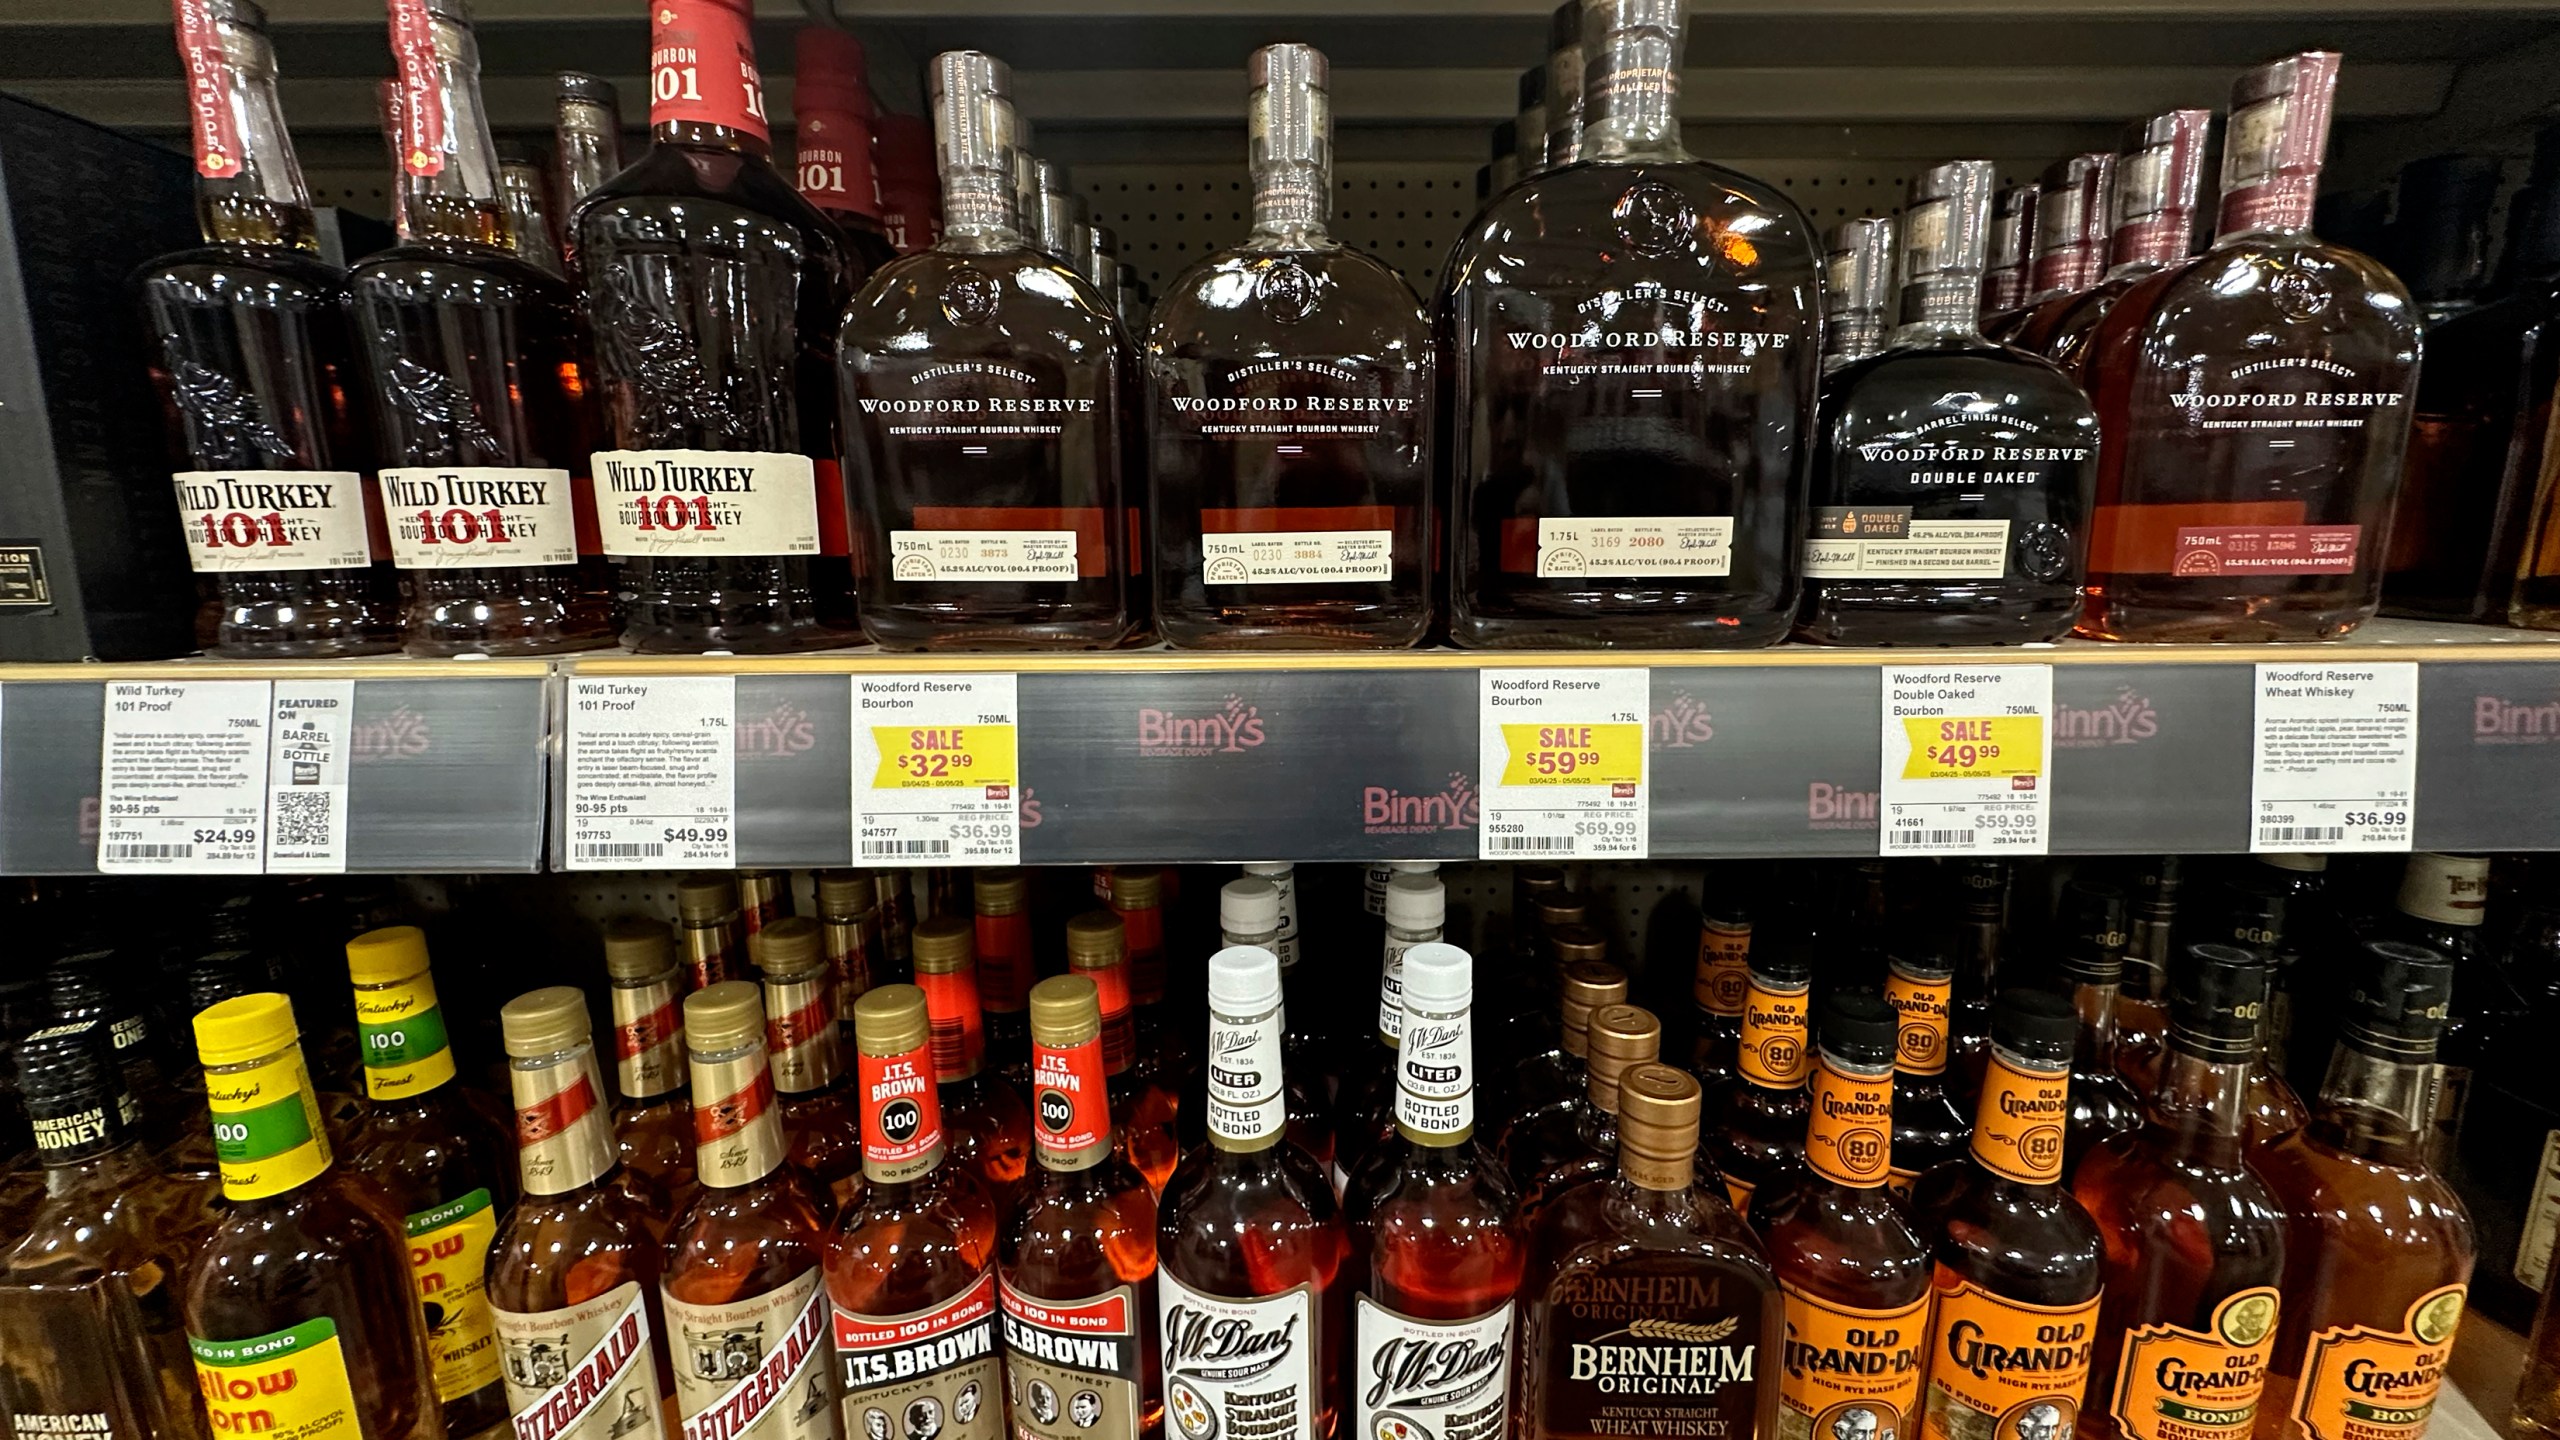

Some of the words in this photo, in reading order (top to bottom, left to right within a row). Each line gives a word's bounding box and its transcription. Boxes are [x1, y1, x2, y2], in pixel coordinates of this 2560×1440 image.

[1508, 332, 1658, 349] WOODFORD
[1671, 330, 1786, 348] RESERVE
[911, 363, 982, 385] DISTILLER'S
[987, 364, 1030, 384] SELECT
[1228, 361, 1302, 383] DISTILLER'S
[1308, 362, 1352, 382] SELECT
[1543, 366, 1597, 375] KENTUCKY
[1601, 365, 1653, 374] STRAIGHT
[1708, 365, 1751, 374] WHISKEY
[2232, 358, 2307, 380] DISTILLER'S
[2311, 360, 2351, 377] SELECT
[859, 398, 980, 414] WOODFORD
[988, 397, 1091, 412] RESERVE
[1172, 397, 1298, 412] WOODFORD
[1306, 396, 1409, 412] RESERVE
[2170, 394, 2297, 408] WOODFORD
[2304, 392, 2399, 406] RESERVE
[935, 426, 977, 434] STRAIGHT
[980, 426, 1020, 434] BOURBON
[1023, 426, 1062, 434] WHISKEY
[1202, 425, 1247, 434] KENTUCKY
[1250, 424, 1294, 433] STRAIGHT
[1296, 424, 1338, 432] BOURBON
[1340, 425, 1380, 433] WHISKEY
[1860, 448, 1985, 462] WOODFORD
[1992, 447, 2084, 461] RESERVE
[606, 461, 656, 492] WILD
[655, 460, 755, 494] TURKEY
[1911, 472, 1976, 484] DOUBLE
[1984, 472, 2035, 484] OAKED
[216, 478, 333, 511] TURKEY
[384, 476, 440, 508] WILD
[438, 474, 547, 508] TURKEY
[636, 495, 717, 531] 101
[676, 511, 742, 526] WHISKEY
[200, 512, 294, 548] 101
[420, 508, 512, 545] 101
[1208, 544, 1245, 554] 750mL
[1591, 536, 1621, 548] 3169
[1629, 537, 1664, 547] 2080
[1893, 674, 1950, 684] Woodford
[1954, 674, 2002, 684] Reserve
[2266, 671, 2323, 682] Woodford
[2326, 671, 2374, 681] Reserve
[116, 686, 142, 696] Wild
[146, 686, 186, 698] Turkey
[578, 684, 604, 695] Wild
[608, 684, 648, 696] Turkey
[862, 682, 920, 693] Woodford
[924, 682, 972, 692] Reserve
[1491, 680, 1549, 690] Woodford
[1552, 680, 1601, 690] Reserve
[2266, 687, 2302, 697] Wheat
[2306, 687, 2354, 698] Whiskey
[1491, 696, 1542, 706] Bourbon
[1893, 690, 1935, 700] Double
[1938, 690, 1975, 700] Oaked
[115, 702, 136, 712] 101
[138, 702, 172, 712] Proof
[278, 699, 338, 708] FEATURED
[578, 700, 598, 710] 101
[602, 700, 636, 711] Proof
[862, 698, 914, 709] Bourbon
[1893, 706, 1944, 716] Bourbon
[2006, 705, 2039, 715] 750ML
[2378, 704, 2411, 713] 750ML
[228, 718, 262, 728] 750ML
[278, 710, 296, 720] ON
[700, 718, 728, 727] 1.75L
[977, 714, 1011, 724] 750ML
[1611, 713, 1638, 722] 1.75L
[282, 730, 331, 742] BARREL
[1539, 728, 1592, 748] SALE
[1940, 720, 1992, 742] SALE
[910, 730, 964, 750] SALE
[282, 750, 330, 763] BOTTLE
[576, 794, 588, 802] The
[590, 794, 608, 802] Wine
[608, 794, 646, 802] Enthusiast
[110, 804, 140, 814] 90-95
[142, 804, 160, 816] pts
[576, 804, 607, 813] 90-95
[610, 804, 628, 815] pts
[1975, 814, 2037, 829] $59.99
[2260, 815, 2295, 824] 980399
[2344, 812, 2406, 827] $36.99
[108, 832, 143, 841] 197751
[193, 830, 256, 844] $24.99
[576, 831, 612, 840] 197753
[664, 828, 728, 843] $49.99
[862, 828, 898, 838] 947577
[950, 824, 1012, 840] $36.99
[1488, 824, 1524, 834] 955280
[1574, 822, 1637, 836] $69.99
[370, 1030, 406, 1049] 100
[1040, 1054, 1070, 1073] J.T.S.
[1411, 1063, 1457, 1080] LITER
[882, 1062, 916, 1082] J.T.S.
[1214, 1068, 1255, 1086] LITER
[871, 1076, 926, 1103] BROWN
[1854, 1092, 1880, 1102] OLD
[1042, 1102, 1068, 1120] 100
[1210, 1102, 1260, 1122] BOTTLED
[1404, 1098, 1460, 1118] BOTTLED
[32, 1107, 104, 1132] AMERICAN
[886, 1110, 917, 1131] 100
[1210, 1114, 1220, 1129] IN
[1222, 1122, 1262, 1135] BOND
[1404, 1110, 1416, 1124] IN
[1420, 1116, 1460, 1130] BOND
[34, 1118, 106, 1150] HONEY
[1850, 1140, 1878, 1156] 80
[846, 1330, 896, 1343] BOTTLED
[900, 1320, 930, 1337] 100
[933, 1316, 948, 1328] IN
[952, 1301, 984, 1322] BOND
[1024, 1304, 1048, 1322] 100
[1050, 1314, 1066, 1324] IN
[1070, 1316, 1108, 1327] BOND
[1846, 1328, 1900, 1348] OLD
[2036, 1322, 2086, 1343] OLD
[217, 1348, 236, 1358] IN
[242, 1336, 296, 1356] BOND
[698, 1295, 822, 1440] FITZGERALD
[1570, 1344, 1756, 1383] BERNHEIM
[2225, 1353, 2259, 1370] OLD
[516, 1312, 640, 1440] FITZGERALD
[1812, 1376, 1841, 1392] HIGH
[199, 1368, 296, 1402] ellow
[1598, 1376, 1715, 1394] ORIGINAL
[1602, 1408, 1662, 1418] KENTUCKY
[1665, 1408, 1719, 1418] STRAIGHT
[14, 1414, 108, 1432] AMERICAN
[1590, 1420, 1648, 1434] WHEAT
[1654, 1420, 1729, 1437] WHISKEY
